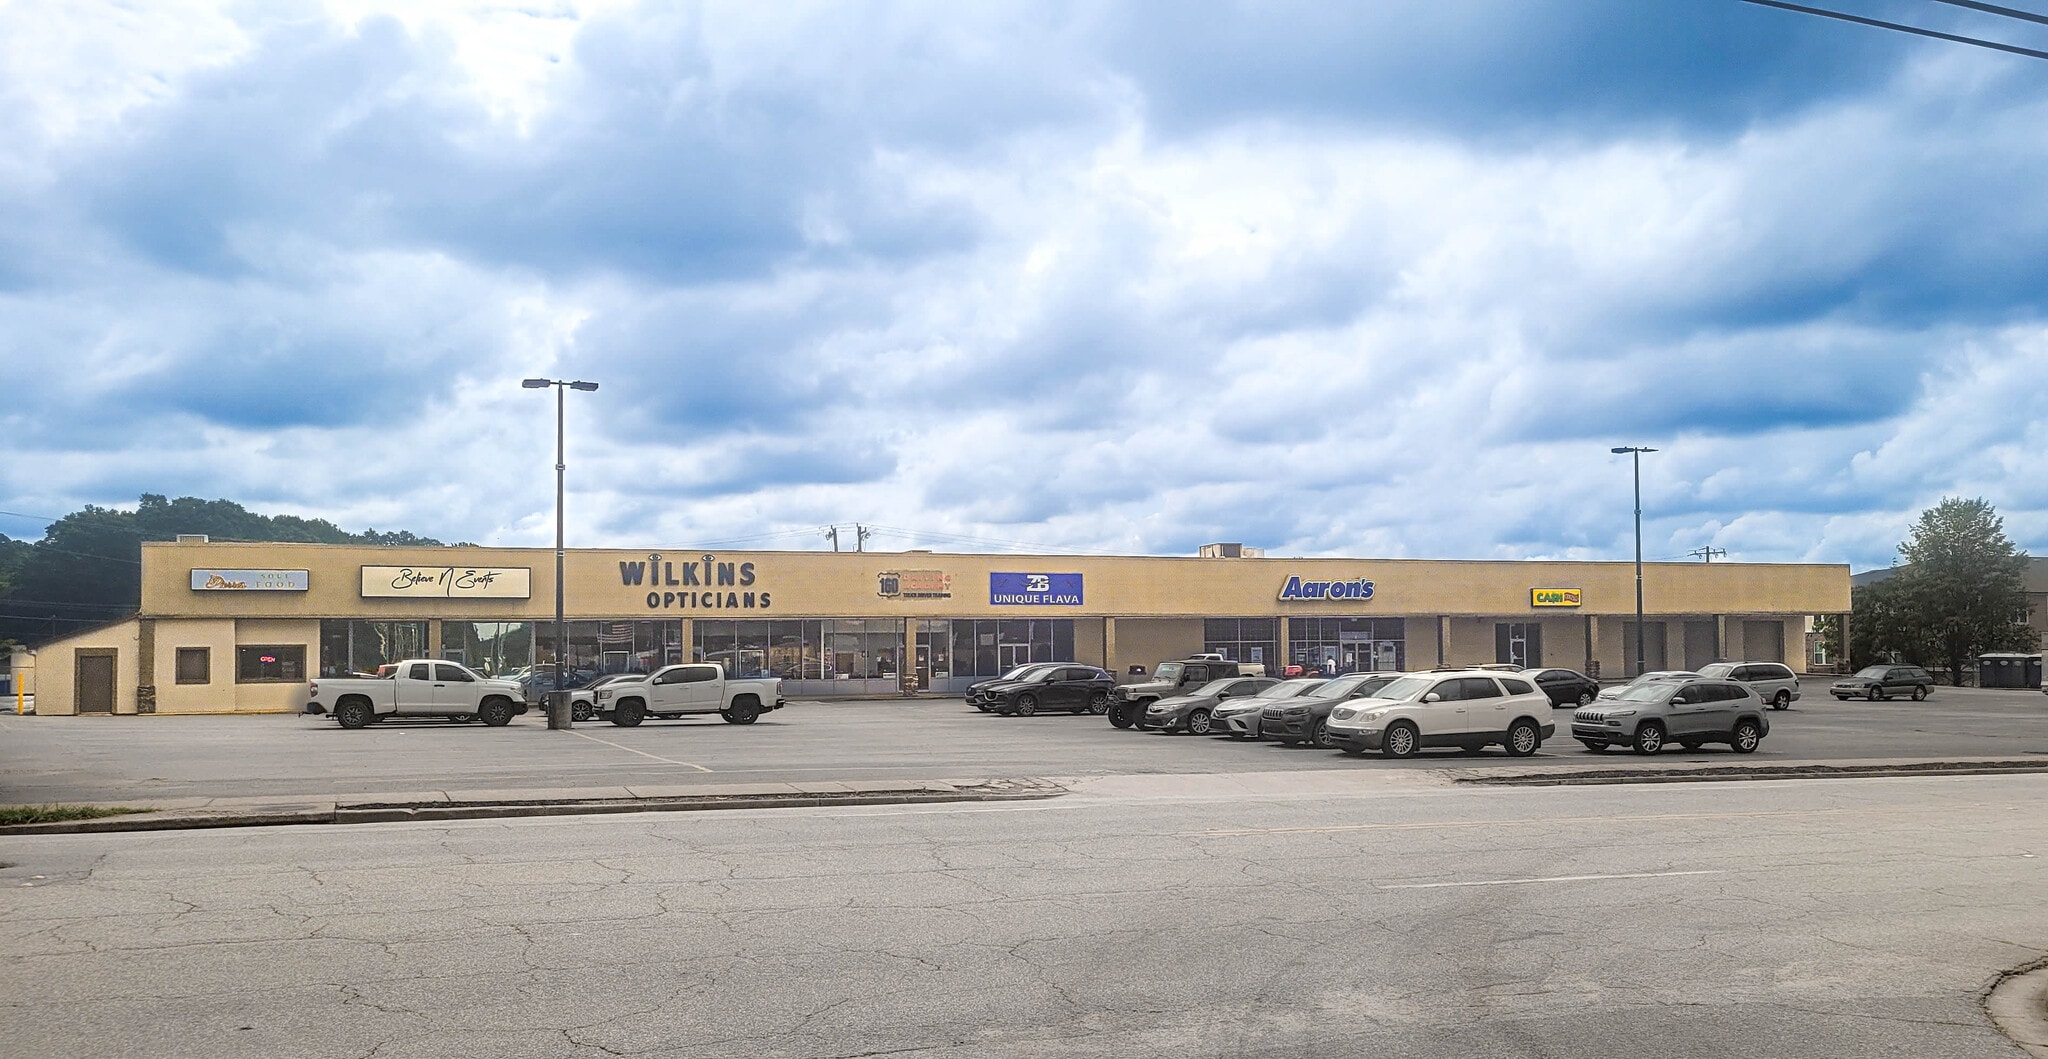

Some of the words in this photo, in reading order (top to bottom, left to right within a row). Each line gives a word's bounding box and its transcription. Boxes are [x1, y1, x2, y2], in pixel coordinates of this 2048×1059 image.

[391, 568, 434, 590] Believe
[438, 567, 454, 597] N
[455, 570, 502, 590] Events
[619, 554, 755, 586] WILKINS
[994, 594, 1040, 604] UNIQUE
[1043, 595, 1079, 604] FLAVA
[1281, 575, 1375, 599] Aaron's
[646, 592, 771, 609] OPTICIANS
